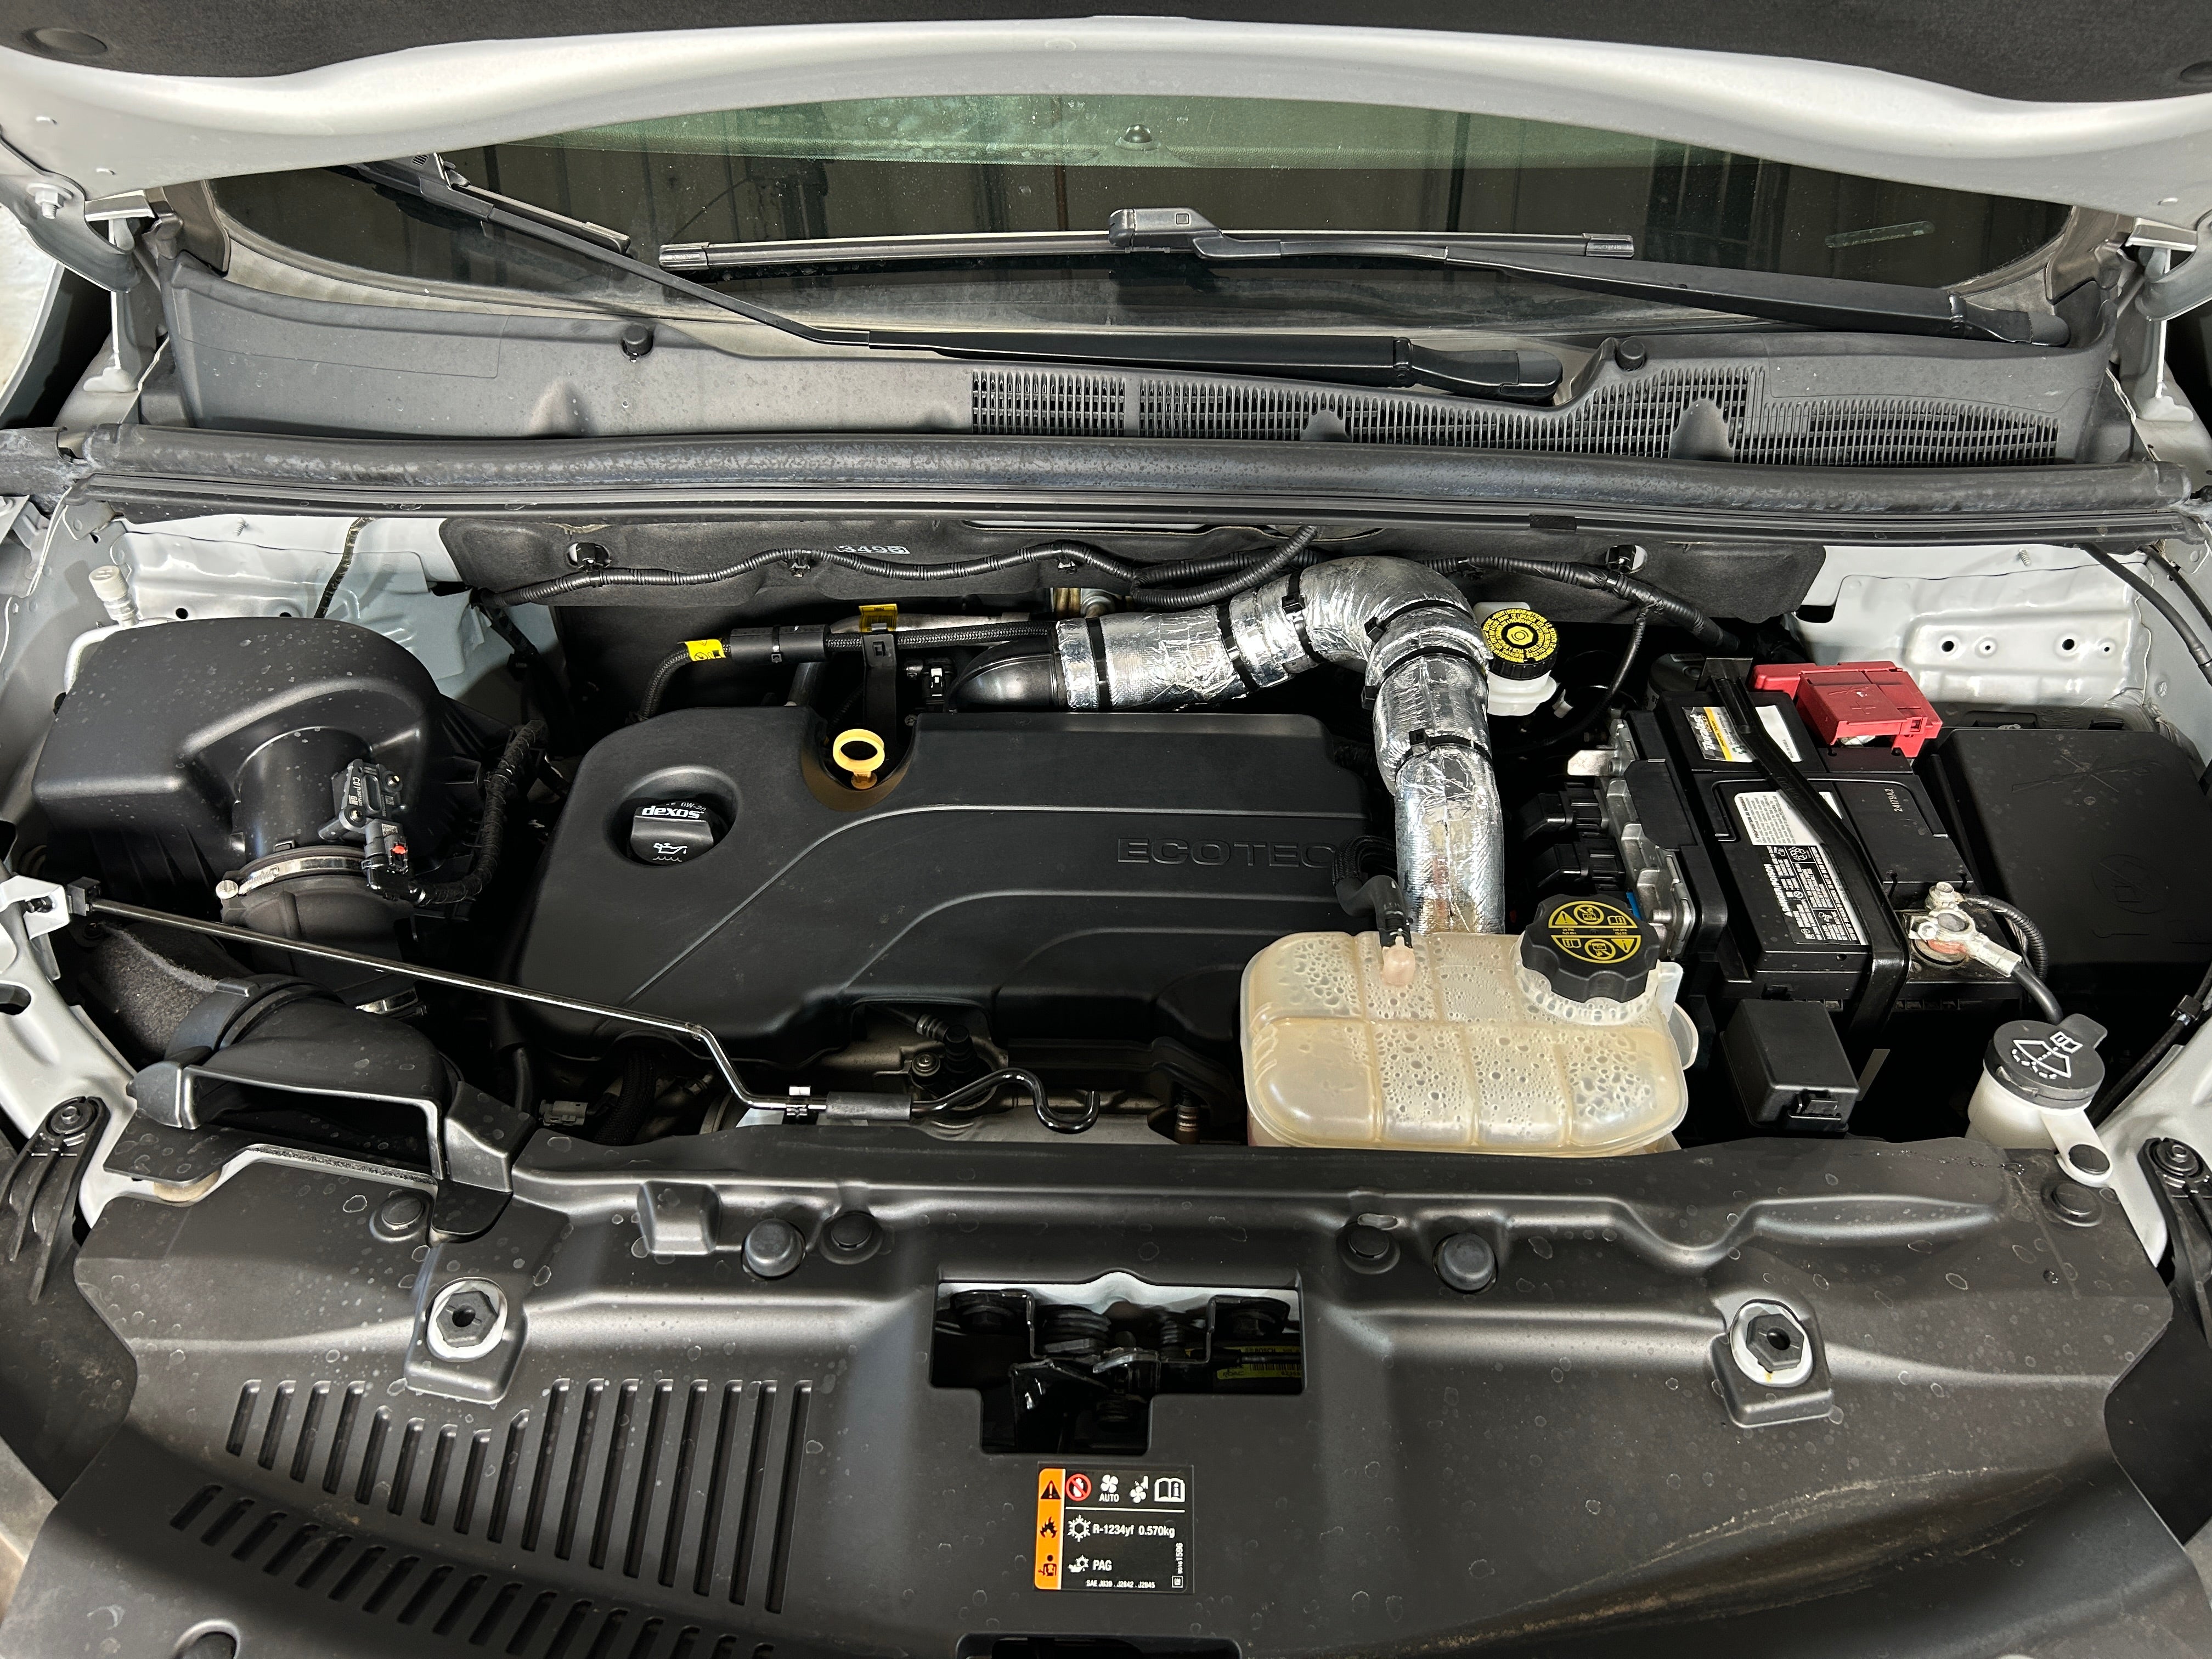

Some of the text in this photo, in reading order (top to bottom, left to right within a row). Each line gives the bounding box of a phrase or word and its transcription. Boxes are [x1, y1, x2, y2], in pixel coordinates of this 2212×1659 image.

[839, 545, 903, 554] 3496
[1690, 713, 1716, 751] Duralast
[1884, 788, 1903, 812] 24179A2
[642, 805, 701, 819] dexos
[1118, 838, 1336, 869] ECOTEC
[1763, 864, 1790, 913] DANGER/POISON
[1099, 1493, 1120, 1502] AUTO
[1093, 1524, 1175, 1538] R-1234yf 0.570kg
[1093, 1560, 1112, 1571] PAG
